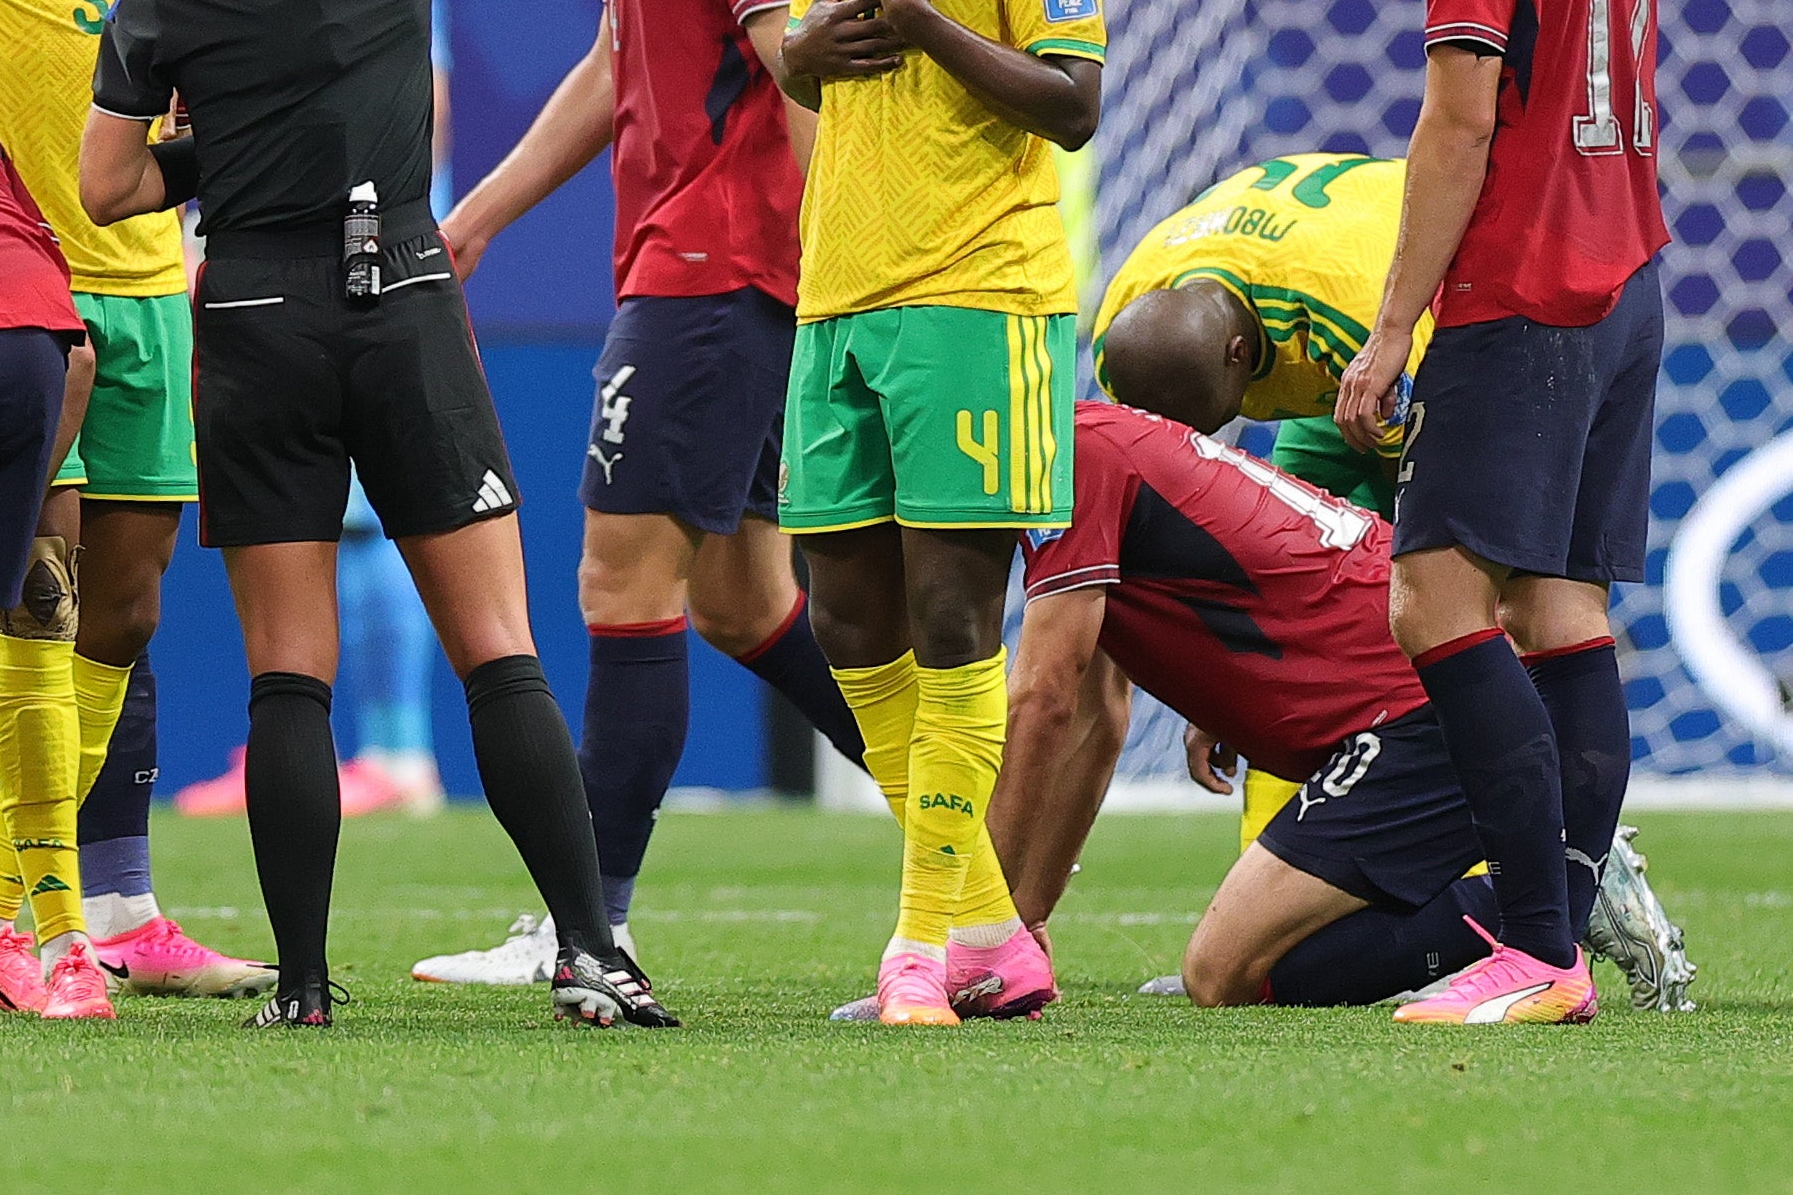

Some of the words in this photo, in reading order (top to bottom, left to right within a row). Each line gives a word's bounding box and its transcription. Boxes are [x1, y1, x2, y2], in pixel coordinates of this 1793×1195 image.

[601, 365, 636, 444] 4
[955, 410, 999, 496] 4
[919, 792, 975, 819] SAFA
